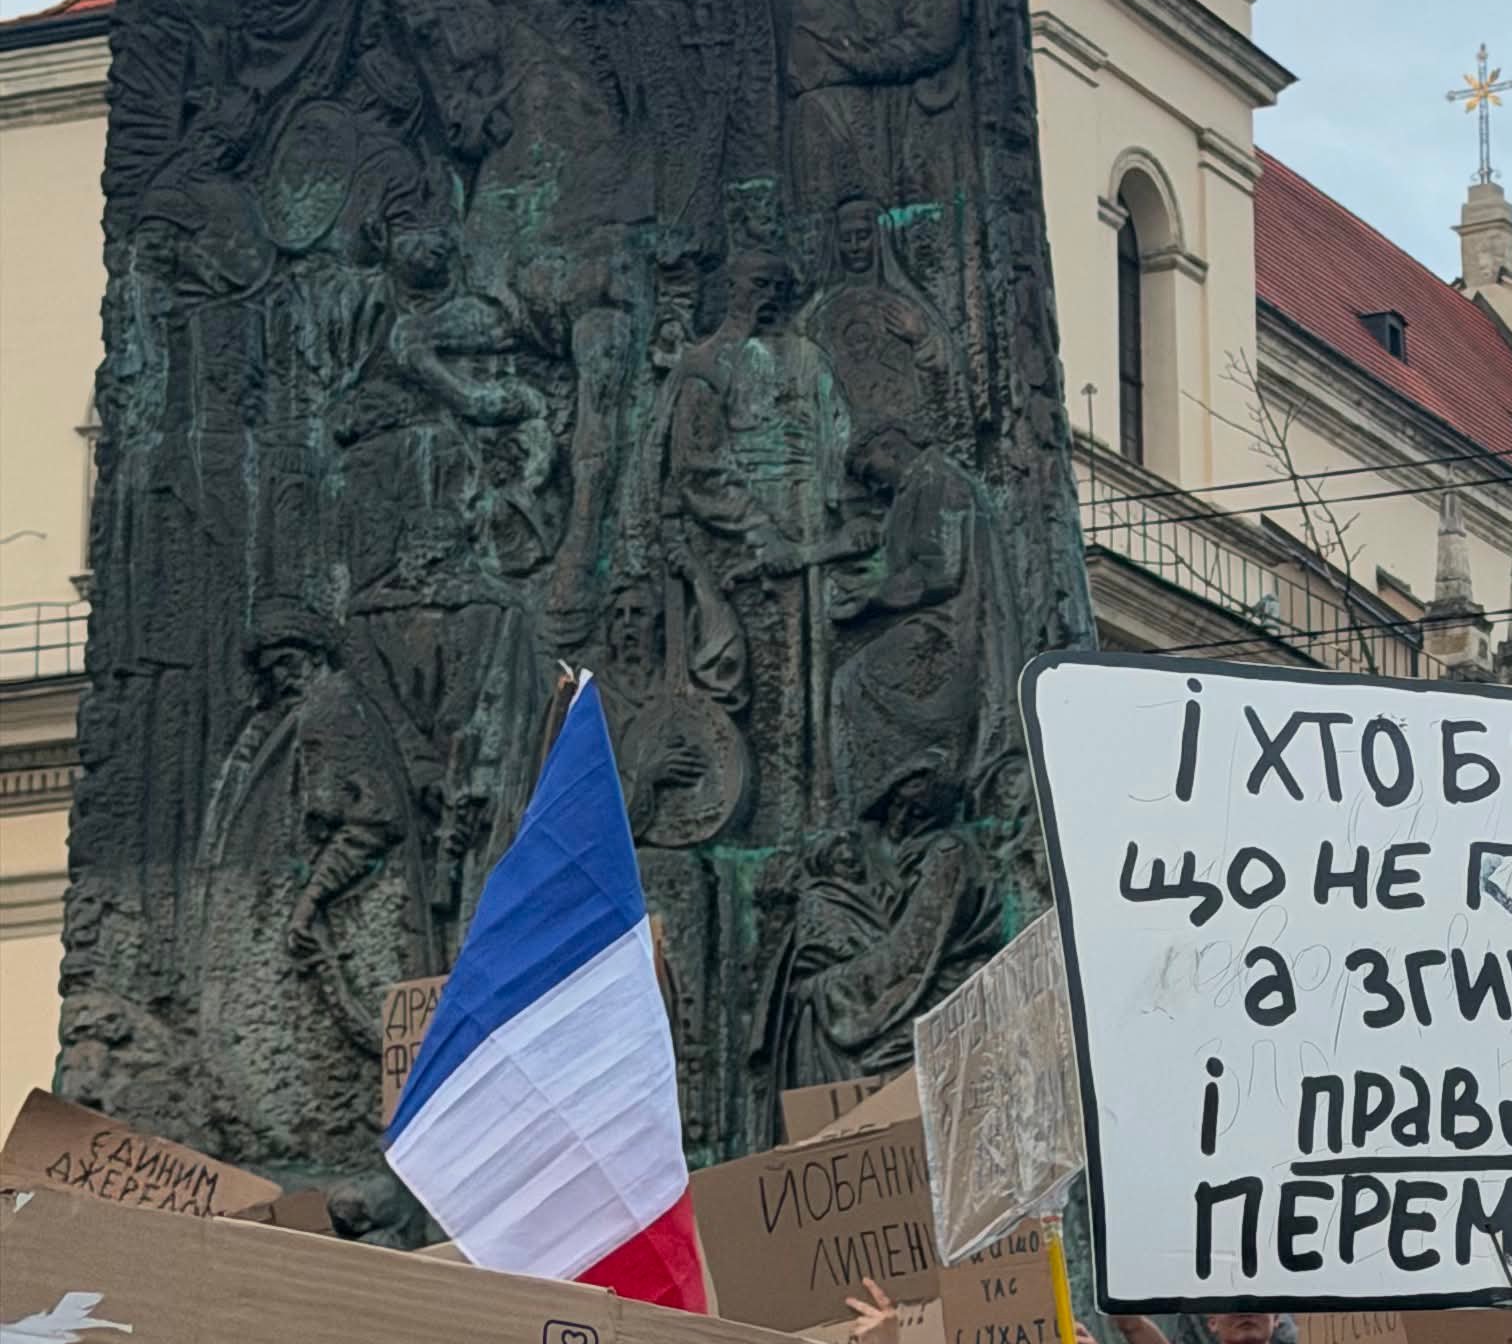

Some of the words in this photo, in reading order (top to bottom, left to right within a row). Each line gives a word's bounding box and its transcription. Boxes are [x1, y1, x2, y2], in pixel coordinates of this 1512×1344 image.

[1244, 706, 1414, 807] ХТО
[1442, 720, 1500, 804] Б
[1119, 841, 1286, 927] ЩО
[1313, 841, 1431, 910] НЕ
